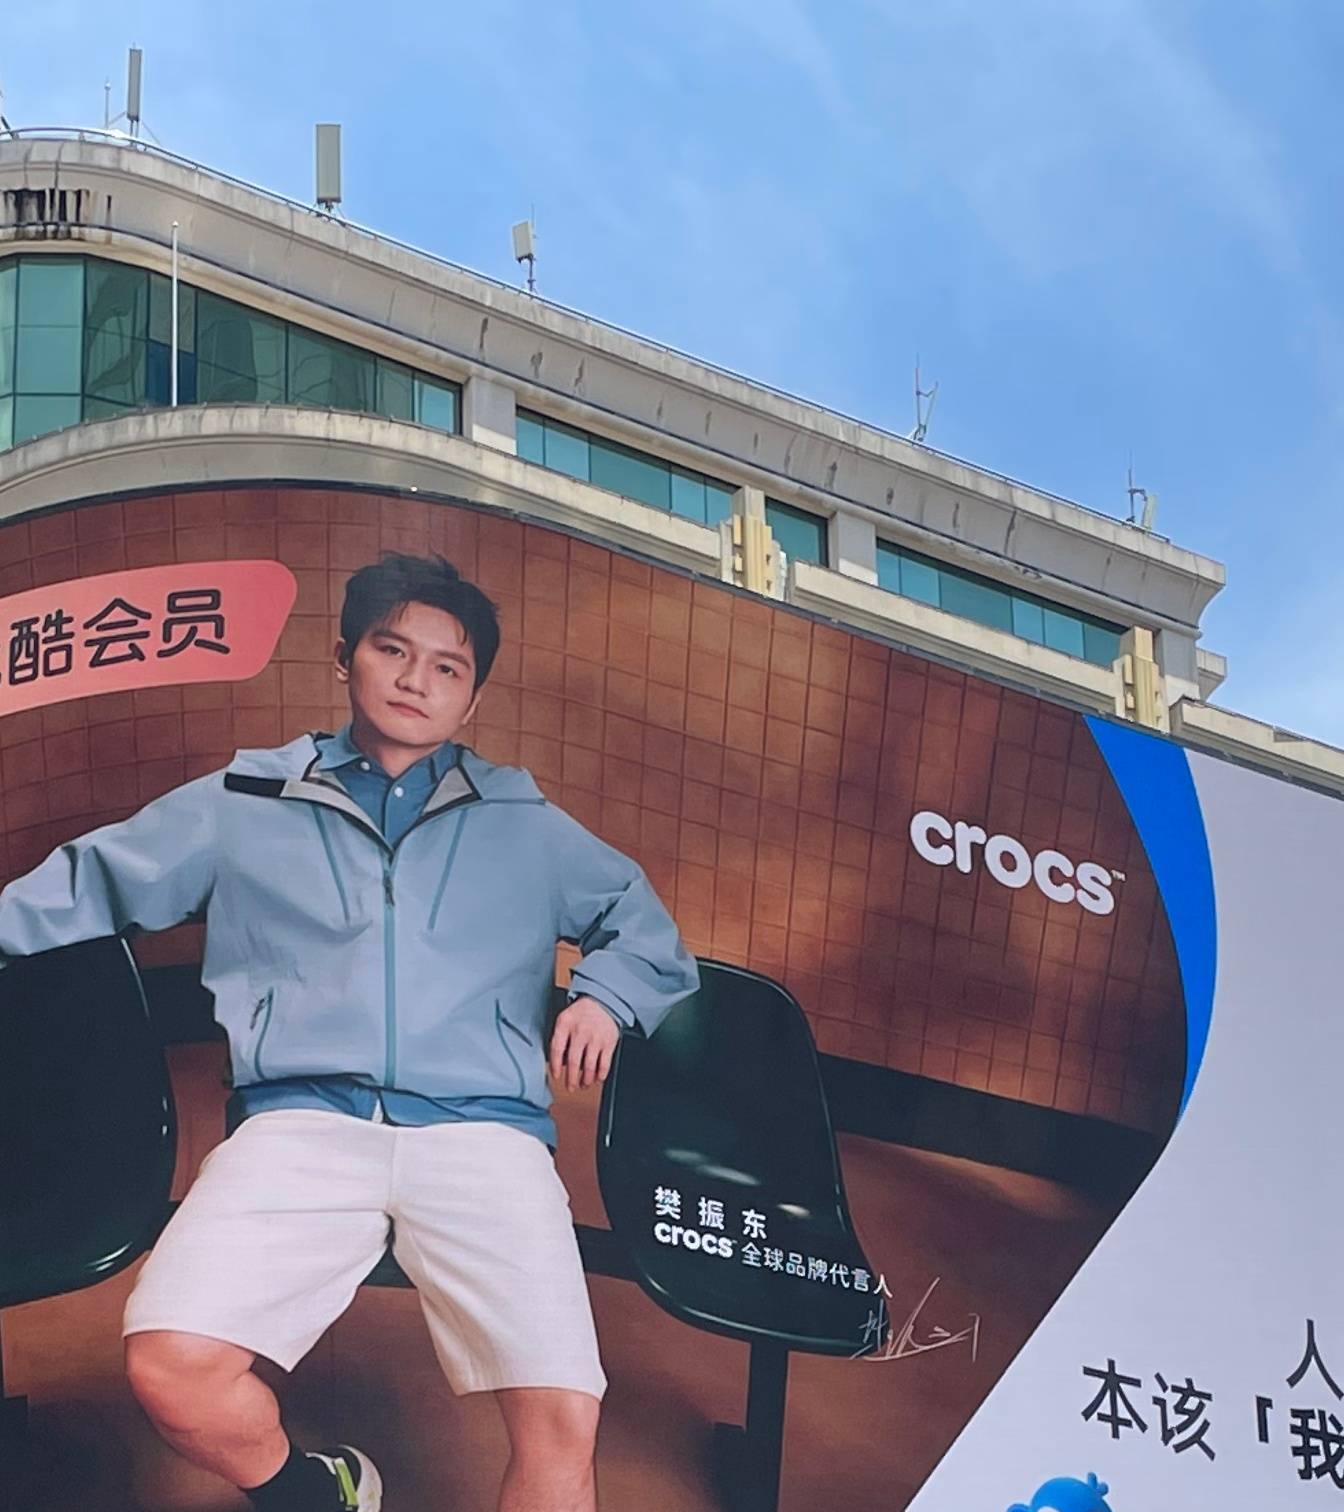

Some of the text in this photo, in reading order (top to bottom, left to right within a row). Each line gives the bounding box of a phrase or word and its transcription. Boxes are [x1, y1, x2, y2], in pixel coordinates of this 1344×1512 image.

[910, 811, 1114, 915] crocs
[655, 1186, 768, 1240] 樊振东
[654, 1222, 893, 1298] crocs 全球品牌代言人
